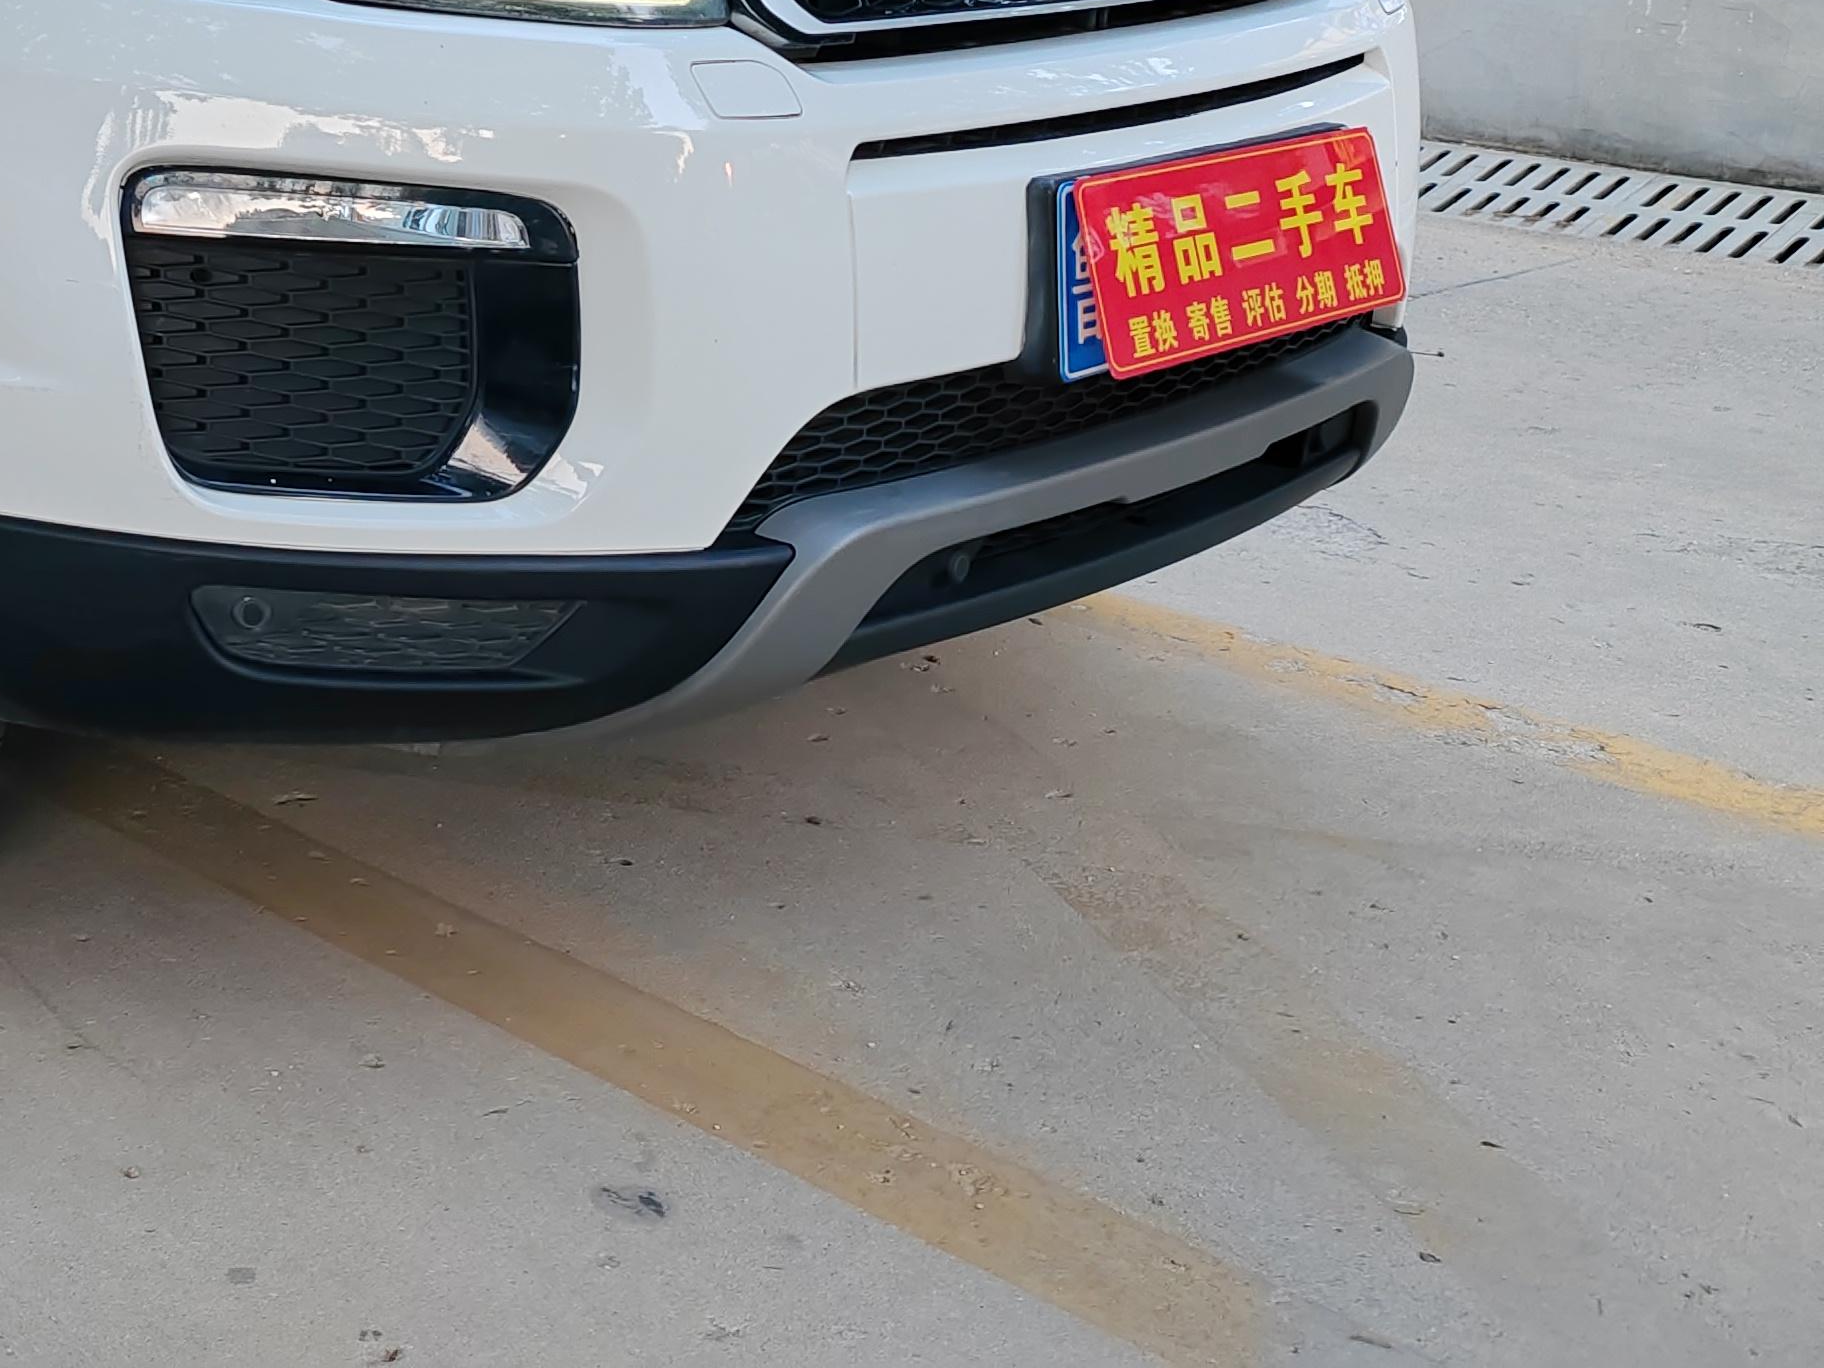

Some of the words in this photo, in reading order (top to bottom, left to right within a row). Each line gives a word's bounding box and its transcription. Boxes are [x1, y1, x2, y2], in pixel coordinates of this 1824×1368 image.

[1105, 161, 1375, 298] 精品二手车
[1128, 309, 1179, 359] 置换
[1185, 296, 1233, 342] 寄售
[1242, 281, 1287, 329] 评估
[1295, 269, 1339, 315] 分期
[1343, 258, 1385, 303] 抵押
